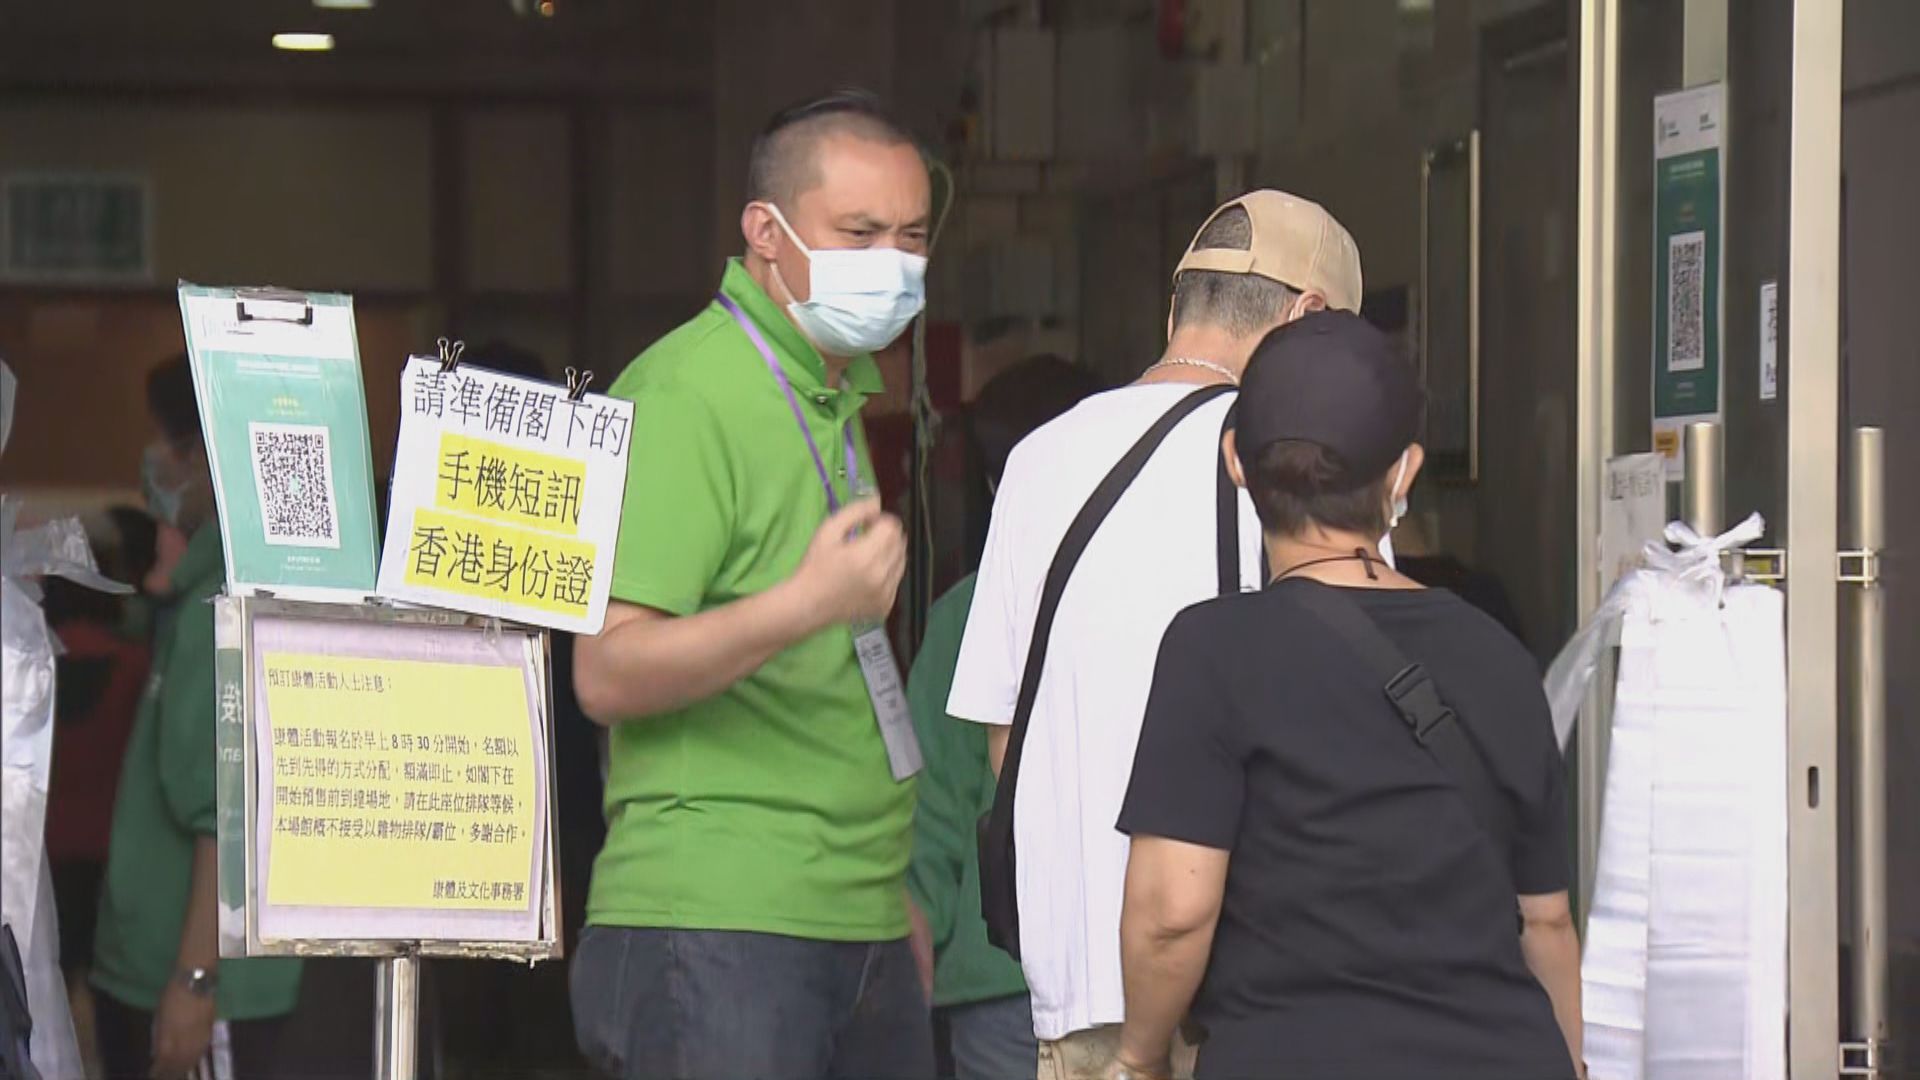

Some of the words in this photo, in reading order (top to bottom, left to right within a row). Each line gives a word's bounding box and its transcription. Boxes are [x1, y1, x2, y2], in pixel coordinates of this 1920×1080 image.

[414, 367, 629, 457] 請準備閣下的
[439, 450, 582, 526] 手機短訊
[410, 526, 595, 606] 香港身份證
